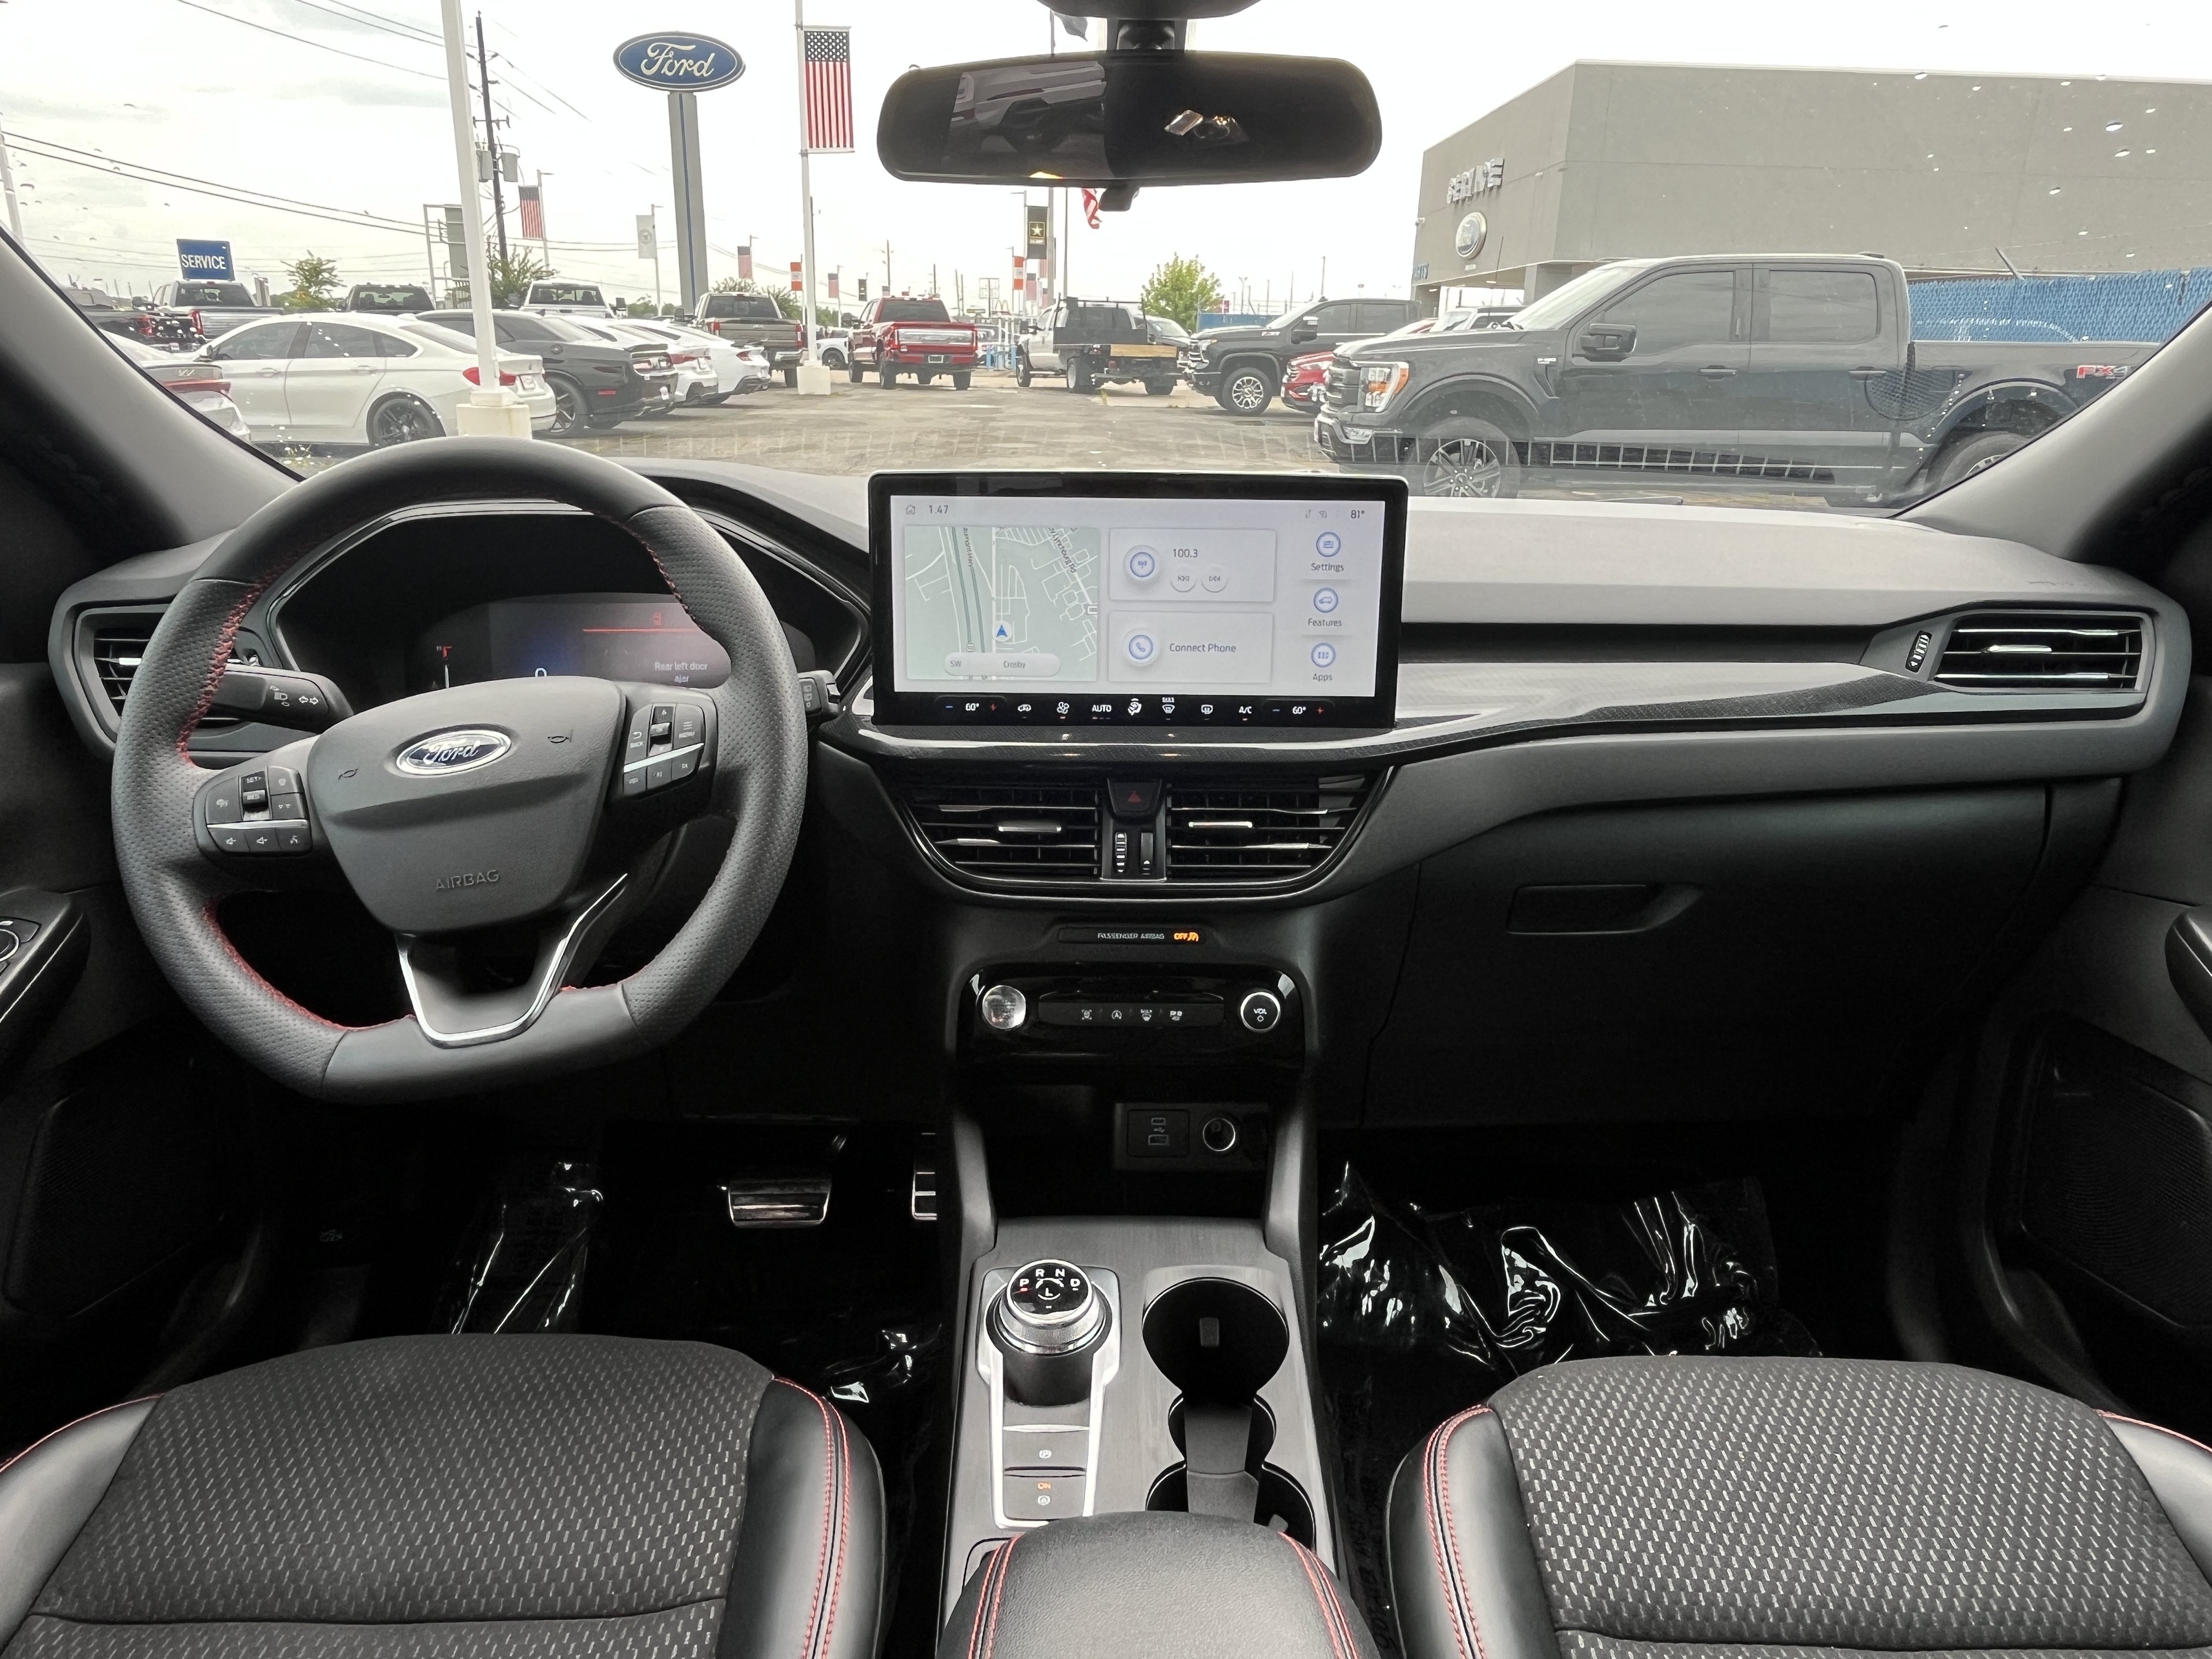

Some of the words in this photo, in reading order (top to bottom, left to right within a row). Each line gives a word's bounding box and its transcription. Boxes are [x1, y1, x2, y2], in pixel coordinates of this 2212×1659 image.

[641, 42, 715, 77] Ford
[181, 254, 227, 269] SERVICE
[929, 505, 949, 514] 1:47
[1351, 510, 1365, 518] 81°
[1173, 549, 1198, 558] 100.3
[1311, 563, 1344, 572] Settings
[1308, 618, 1342, 626] Features
[1170, 643, 1205, 652] Connect
[1208, 644, 1237, 652] Phone
[655, 662, 673, 670] Rear
[675, 661, 689, 670] left
[1003, 661, 1026, 669] Crosby
[1313, 673, 1333, 681] Apps
[423, 739, 481, 765] Ford
[436, 870, 500, 891] AIRBAG
[1019, 1278, 1030, 1287] P
[1035, 1268, 1045, 1277] R
[1055, 1268, 1065, 1277] N
[1070, 1278, 1081, 1287] D
[1045, 1287, 1053, 1296] L
